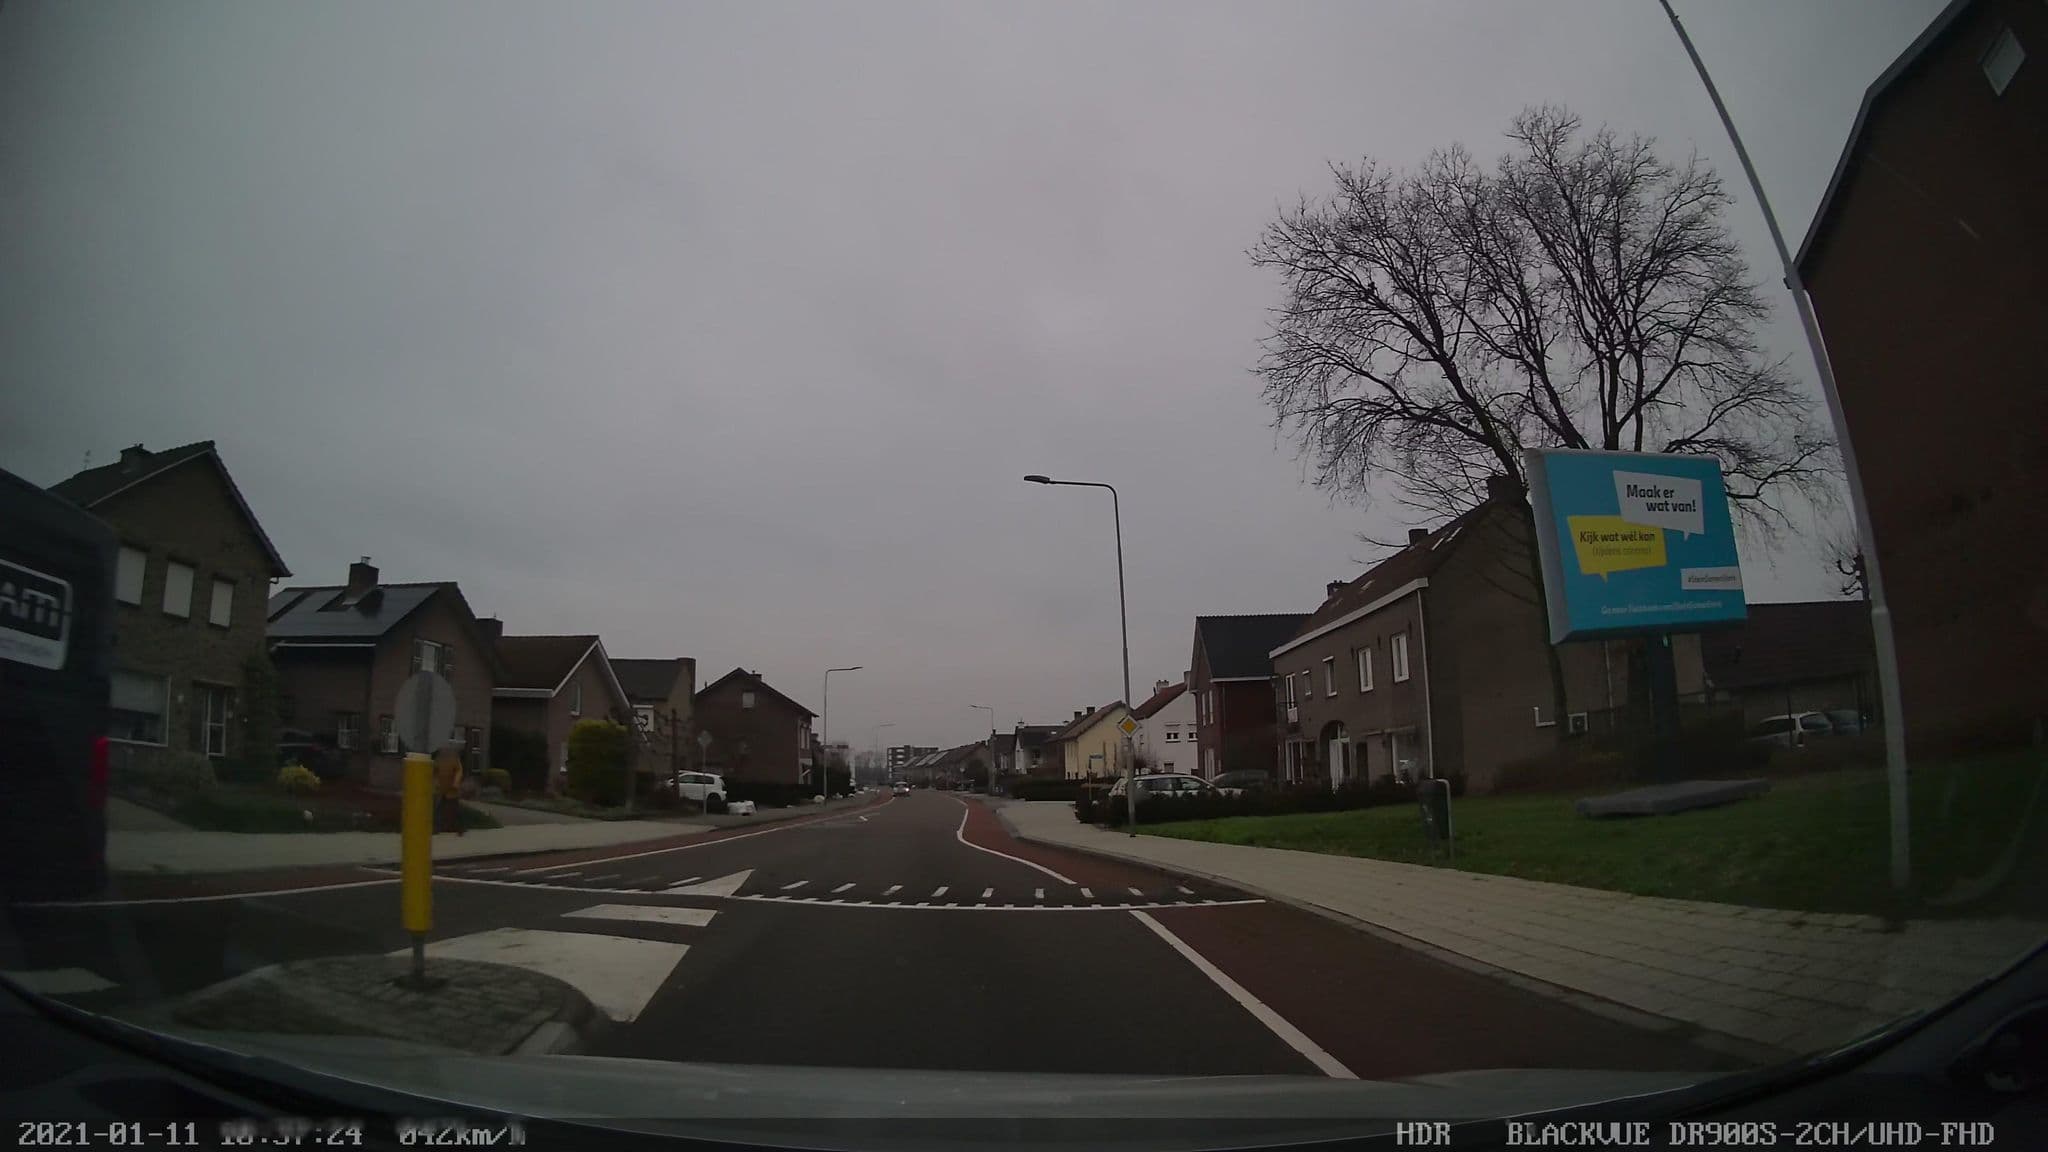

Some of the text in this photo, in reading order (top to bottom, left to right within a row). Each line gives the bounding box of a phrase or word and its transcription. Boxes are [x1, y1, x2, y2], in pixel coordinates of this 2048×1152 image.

[1626, 484, 1674, 498] Maak er
[1646, 500, 1696, 512] wat van!
[1579, 531, 1599, 545] Kijk
[1600, 533, 1618, 542] wat
[1639, 531, 1655, 542] kan
